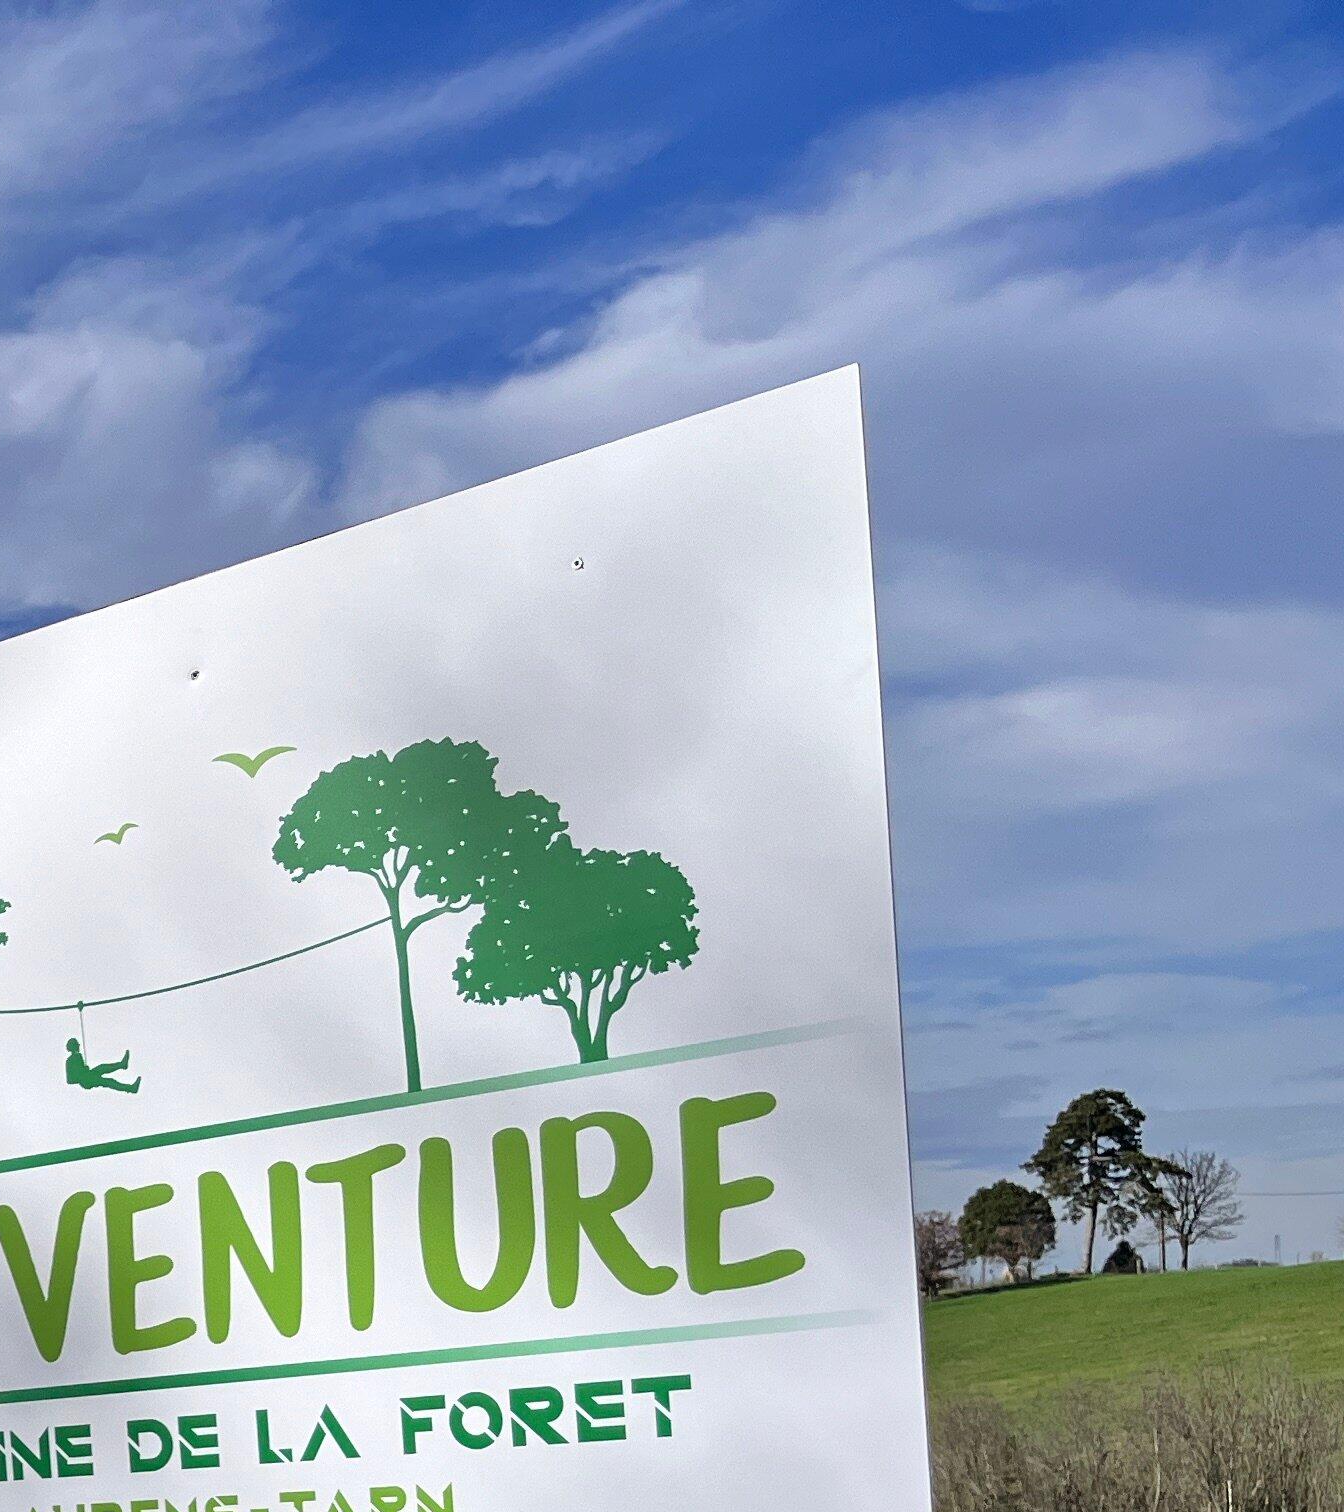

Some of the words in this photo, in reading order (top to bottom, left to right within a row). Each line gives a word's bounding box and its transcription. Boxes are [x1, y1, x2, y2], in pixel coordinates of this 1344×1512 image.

[127, 1413, 221, 1473] DE
[256, 1404, 361, 1465] LA
[399, 1374, 693, 1455] FORET
